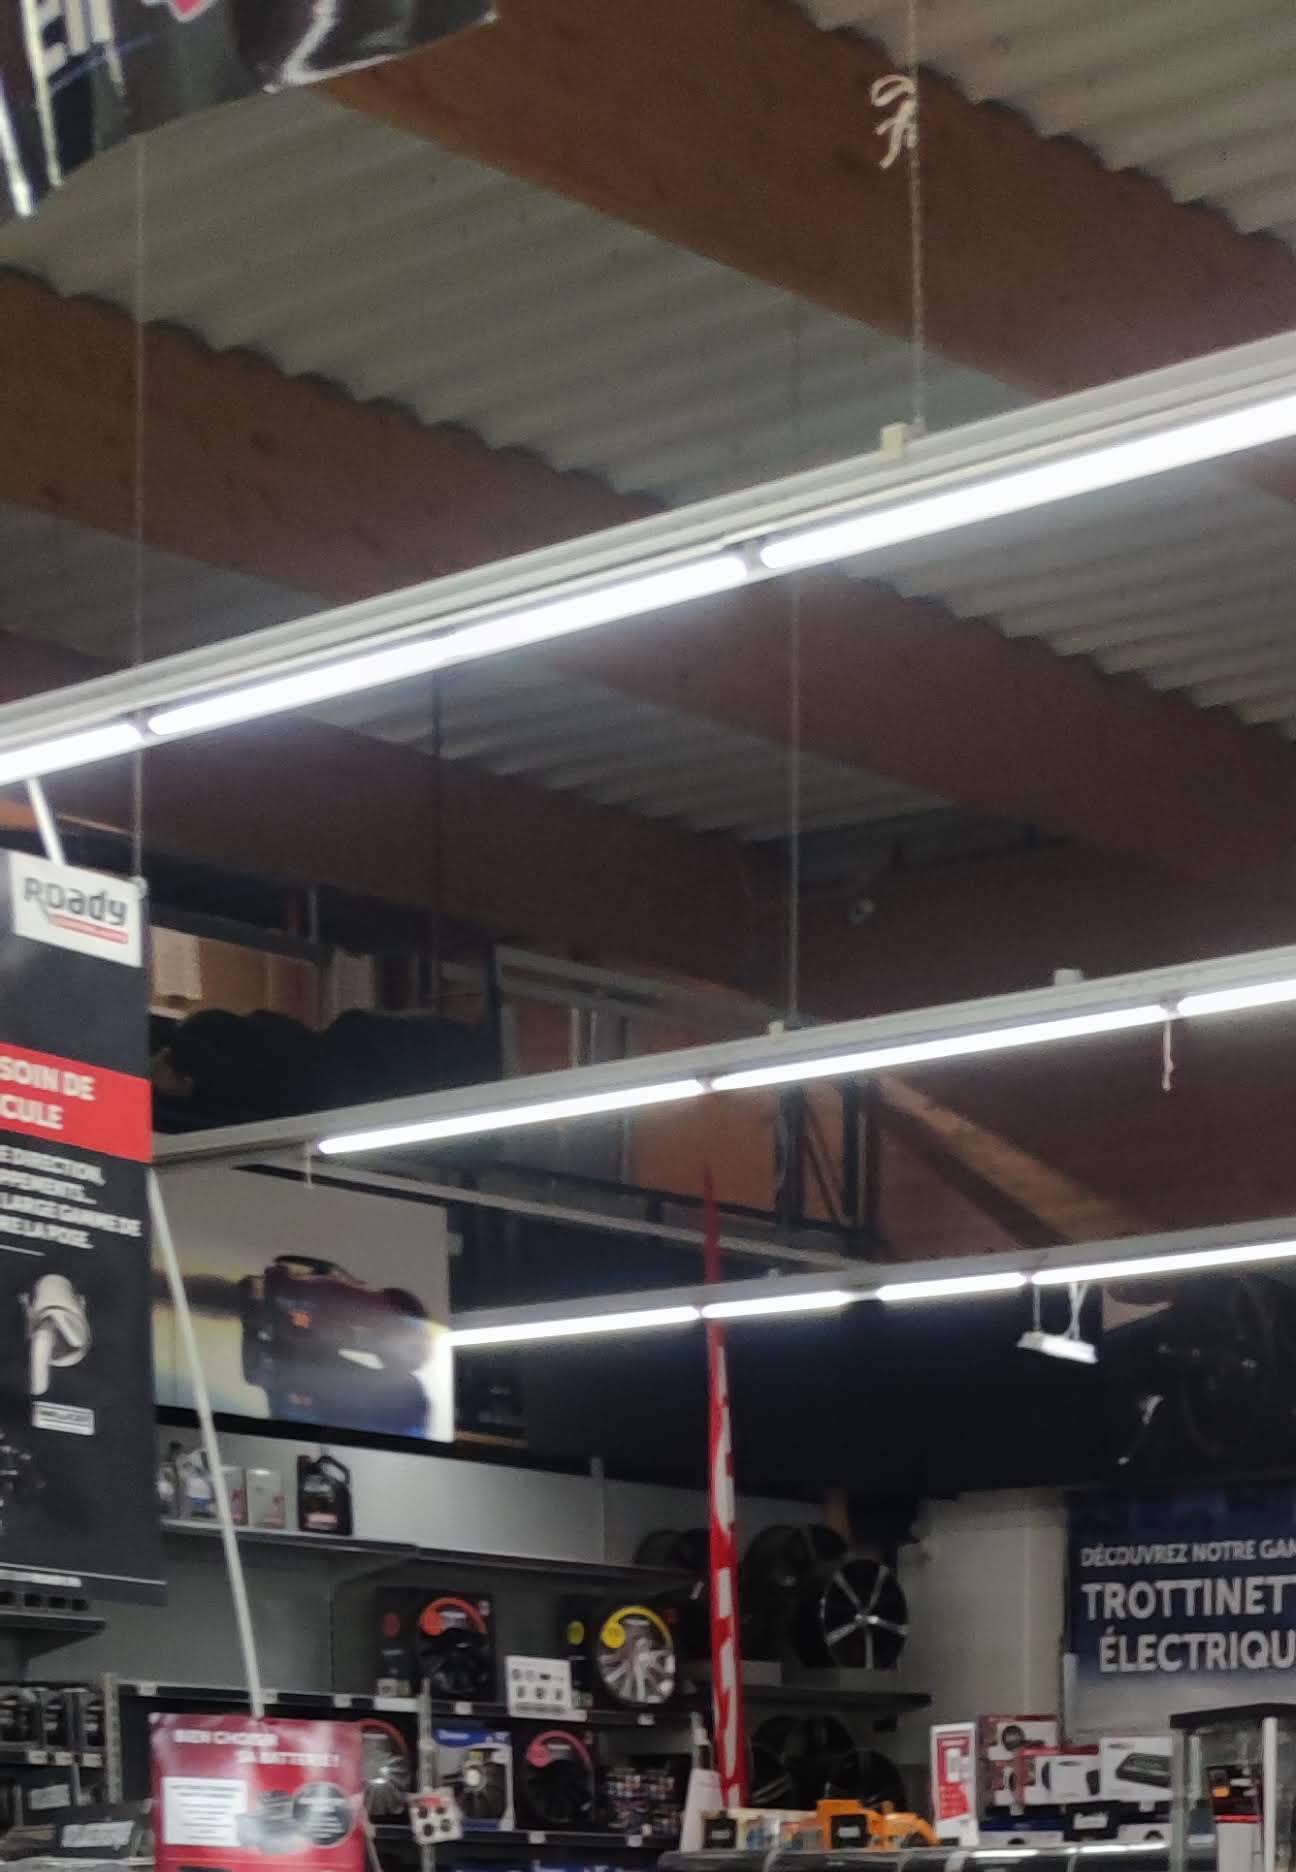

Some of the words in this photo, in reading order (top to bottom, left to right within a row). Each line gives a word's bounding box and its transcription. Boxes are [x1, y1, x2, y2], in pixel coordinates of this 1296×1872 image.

[63, 1071, 96, 1101] DE
[1080, 1541, 1188, 1567] DÉCOUVREZ
[1192, 1539, 1257, 1562] NOTRE
